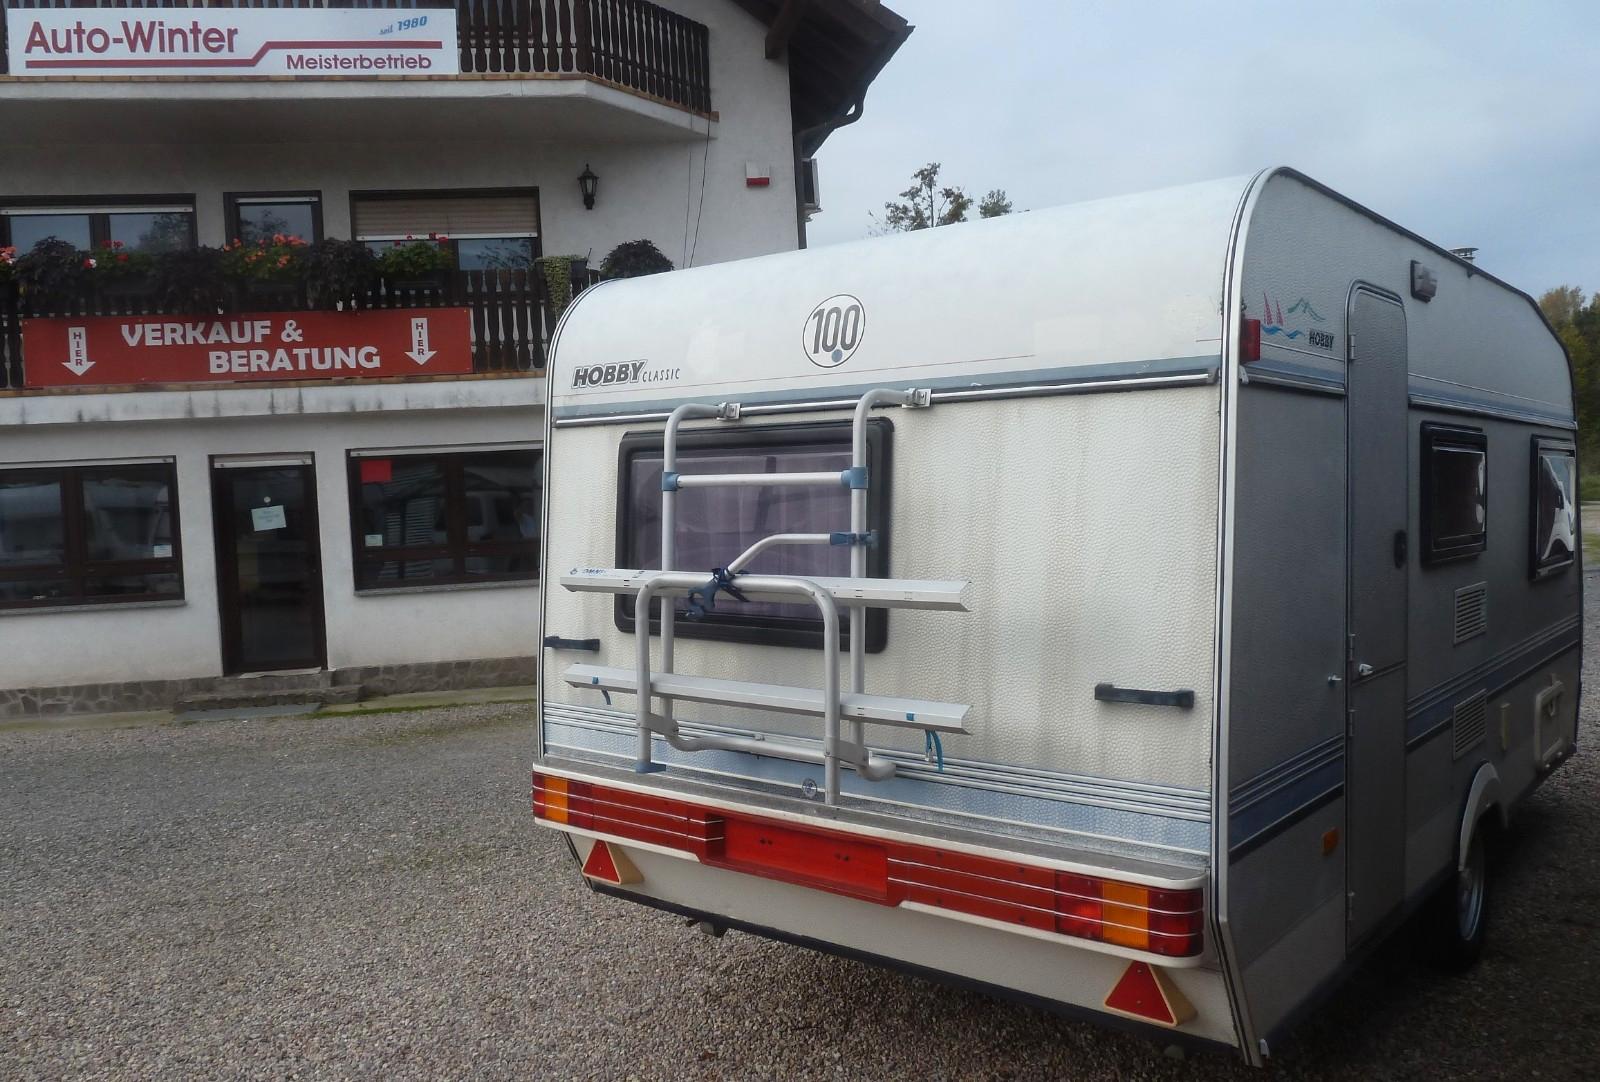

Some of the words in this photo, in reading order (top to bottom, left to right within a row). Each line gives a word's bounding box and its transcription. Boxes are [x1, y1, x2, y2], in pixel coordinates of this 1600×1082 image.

[397, 15, 428, 31] 1980
[25, 21, 239, 54] Auto-Winter
[286, 54, 432, 70] Meisterbetrieb
[121, 320, 272, 347] VERKAUF
[280, 320, 304, 342] &
[415, 322, 425, 356] HIER
[812, 304, 860, 354] 100
[1308, 328, 1335, 349] HOBBY
[73, 331, 83, 367] HIER
[209, 345, 381, 374] BERATUNG
[572, 360, 647, 388] HOBBY
[643, 368, 680, 383] CLASSIC
